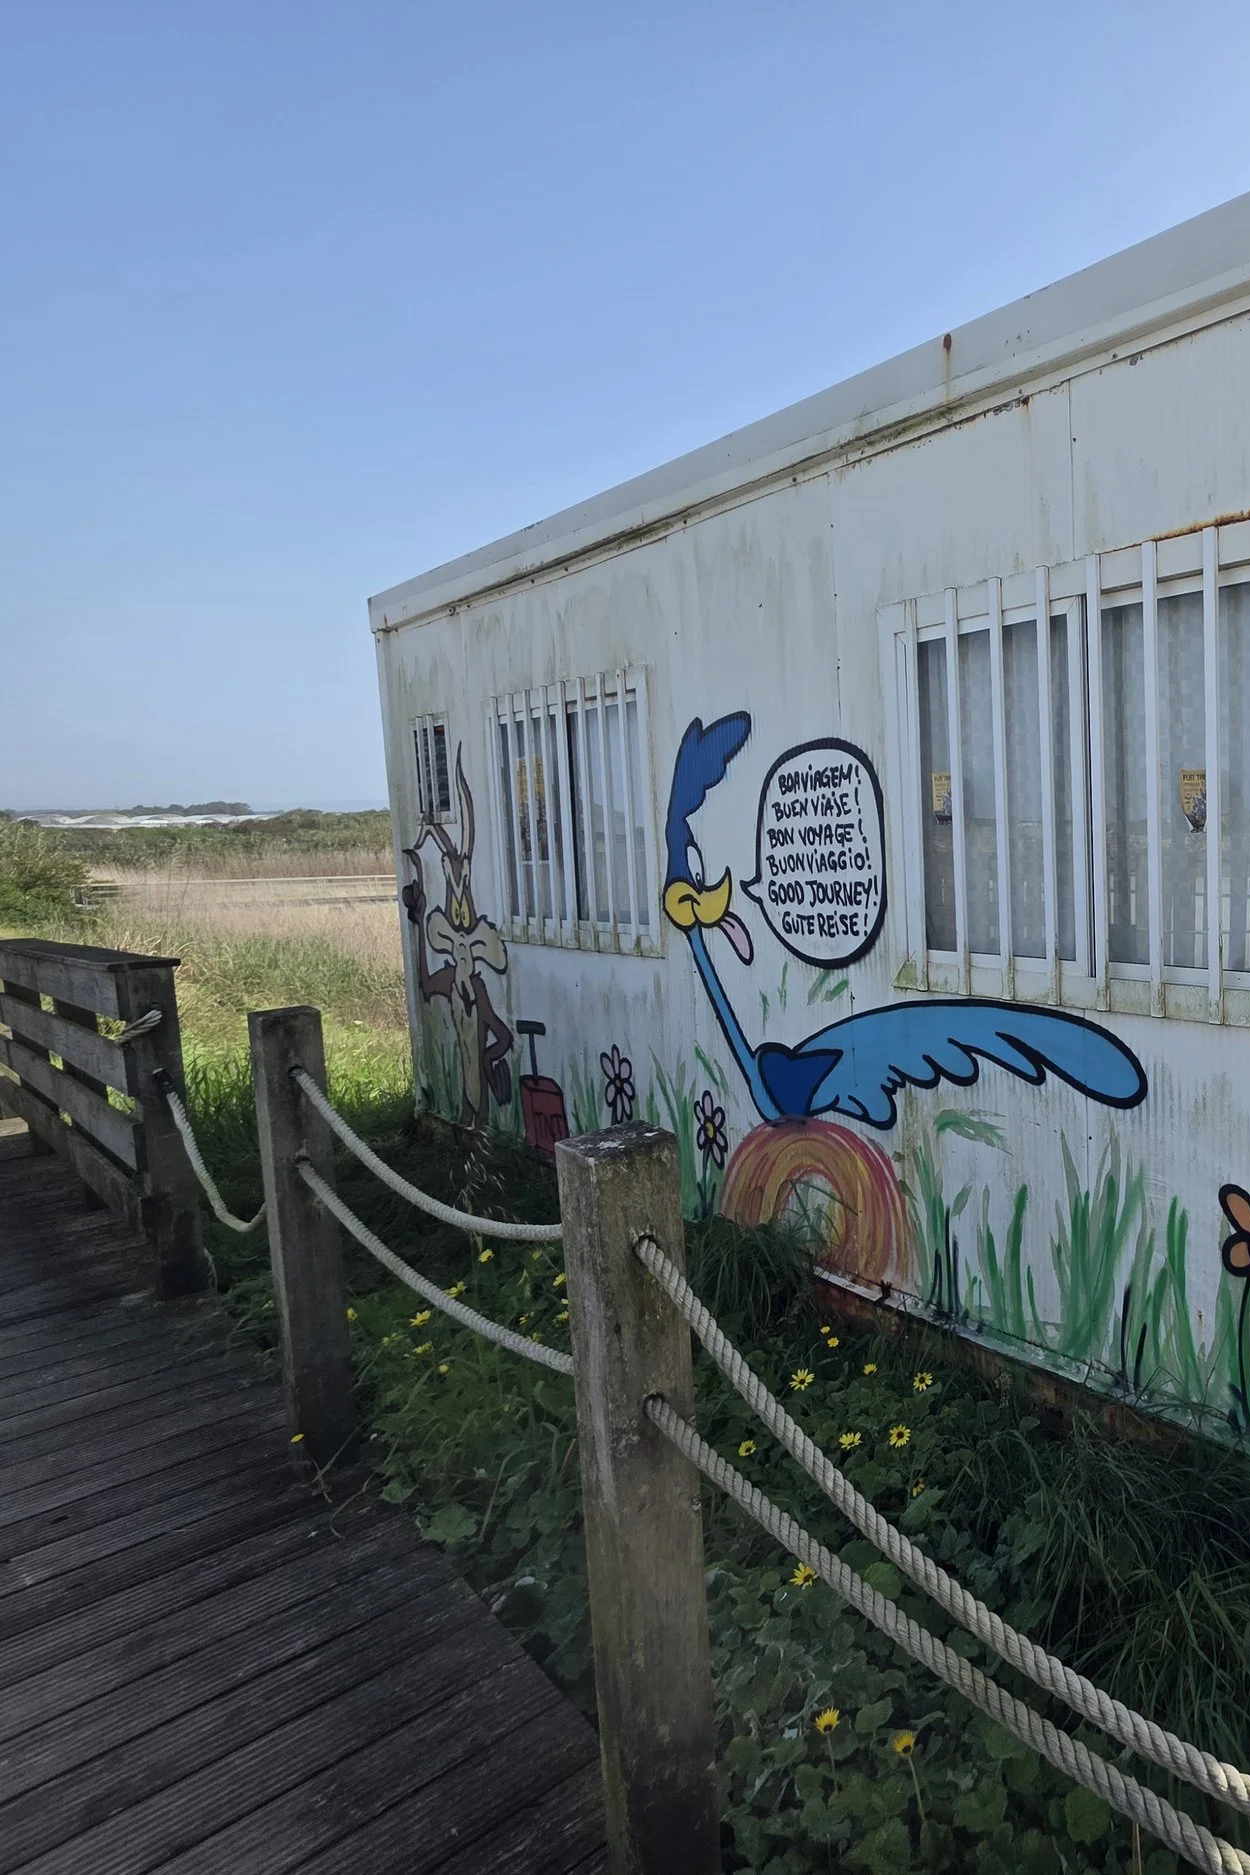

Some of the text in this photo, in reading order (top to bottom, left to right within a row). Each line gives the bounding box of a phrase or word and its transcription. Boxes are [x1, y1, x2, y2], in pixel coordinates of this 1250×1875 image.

[766, 827, 794, 849] BON
[766, 853, 804, 877] BUON
[768, 879, 804, 906] GOOD
